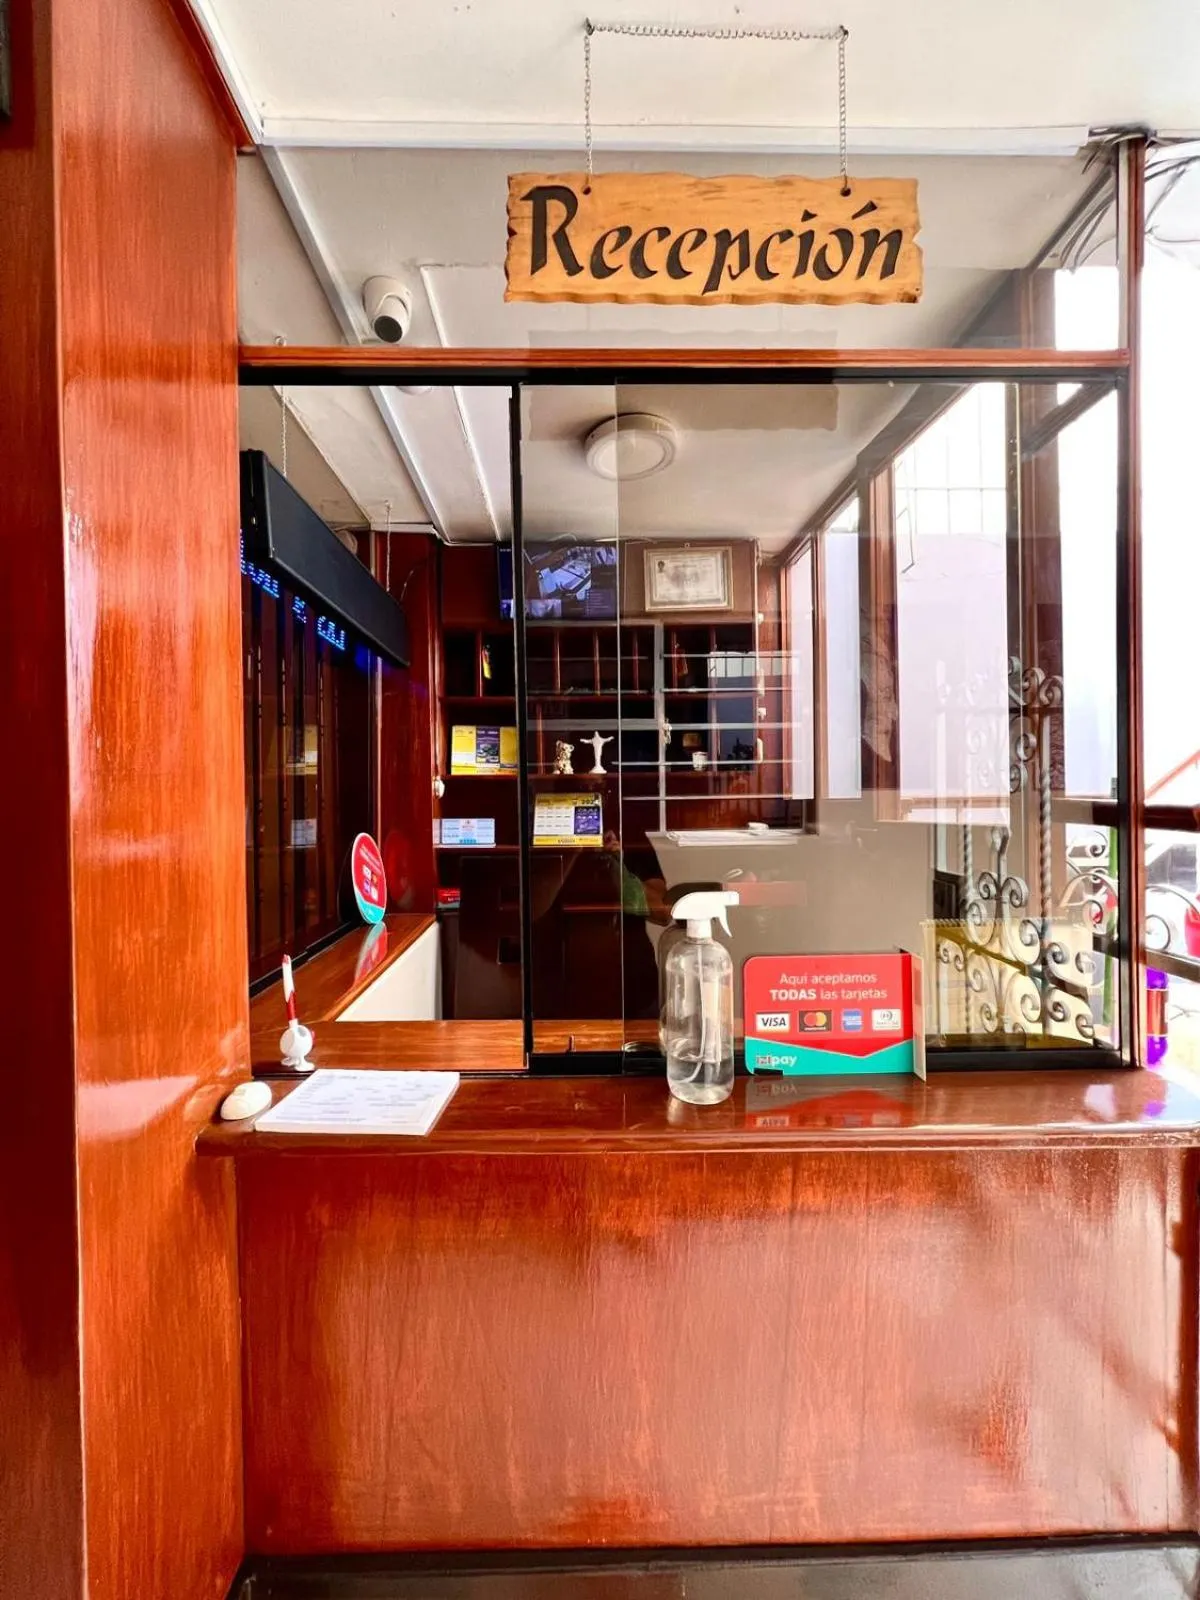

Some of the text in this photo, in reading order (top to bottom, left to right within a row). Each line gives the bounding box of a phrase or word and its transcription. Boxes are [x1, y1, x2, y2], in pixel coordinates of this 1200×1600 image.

[519, 184, 904, 297] Recepción
[811, 972, 878, 986] aceptamos
[769, 987, 888, 1003] TODAS las tarjetas
[761, 1017, 787, 1028] VISA
